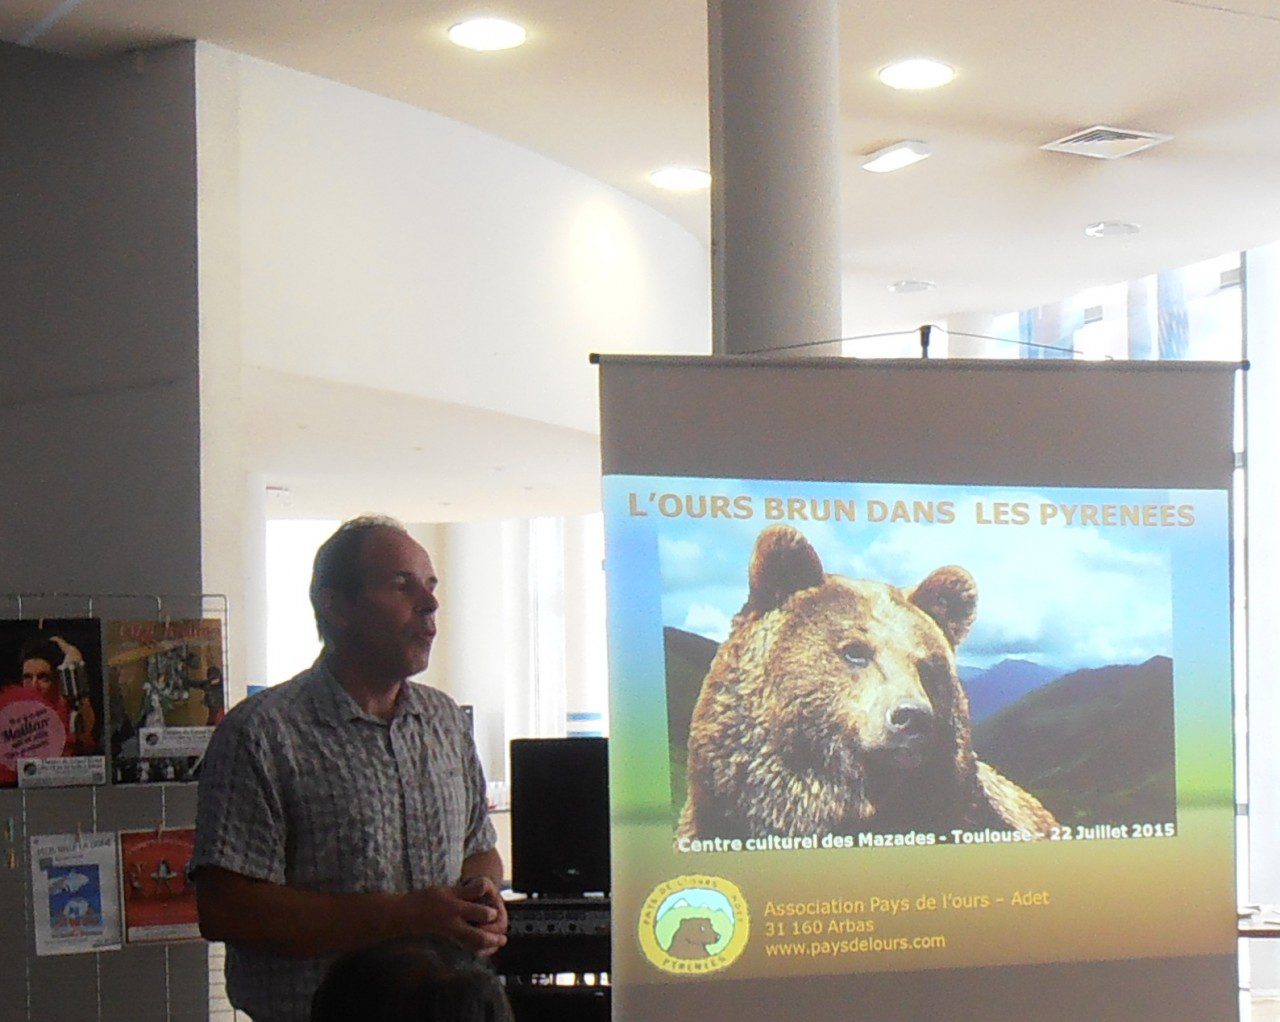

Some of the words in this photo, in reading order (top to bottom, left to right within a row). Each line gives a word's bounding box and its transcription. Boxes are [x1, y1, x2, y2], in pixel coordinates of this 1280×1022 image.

[628, 492, 754, 520] L'OURS
[764, 496, 856, 523] BRUN
[866, 499, 956, 525] DANS
[975, 501, 1031, 526] LES
[1040, 503, 1196, 528] PYRENEES
[678, 837, 742, 853] Centre
[745, 833, 818, 850] culturel
[821, 832, 854, 848] des
[858, 830, 936, 848] Mazades
[951, 828, 1033, 845] Toulouse
[1050, 826, 1073, 841] 22
[1076, 824, 1129, 840] Juillet
[1132, 822, 1175, 838] 2015
[764, 900, 865, 917] Association
[870, 896, 910, 915] Pays
[916, 894, 936, 911] de
[942, 892, 990, 910] l'ours
[1011, 890, 1050, 907] Adet
[765, 921, 785, 938] 31
[792, 920, 823, 936] 160
[827, 917, 875, 934] Arbas
[765, 934, 946, 956] www.paysdelours.com
